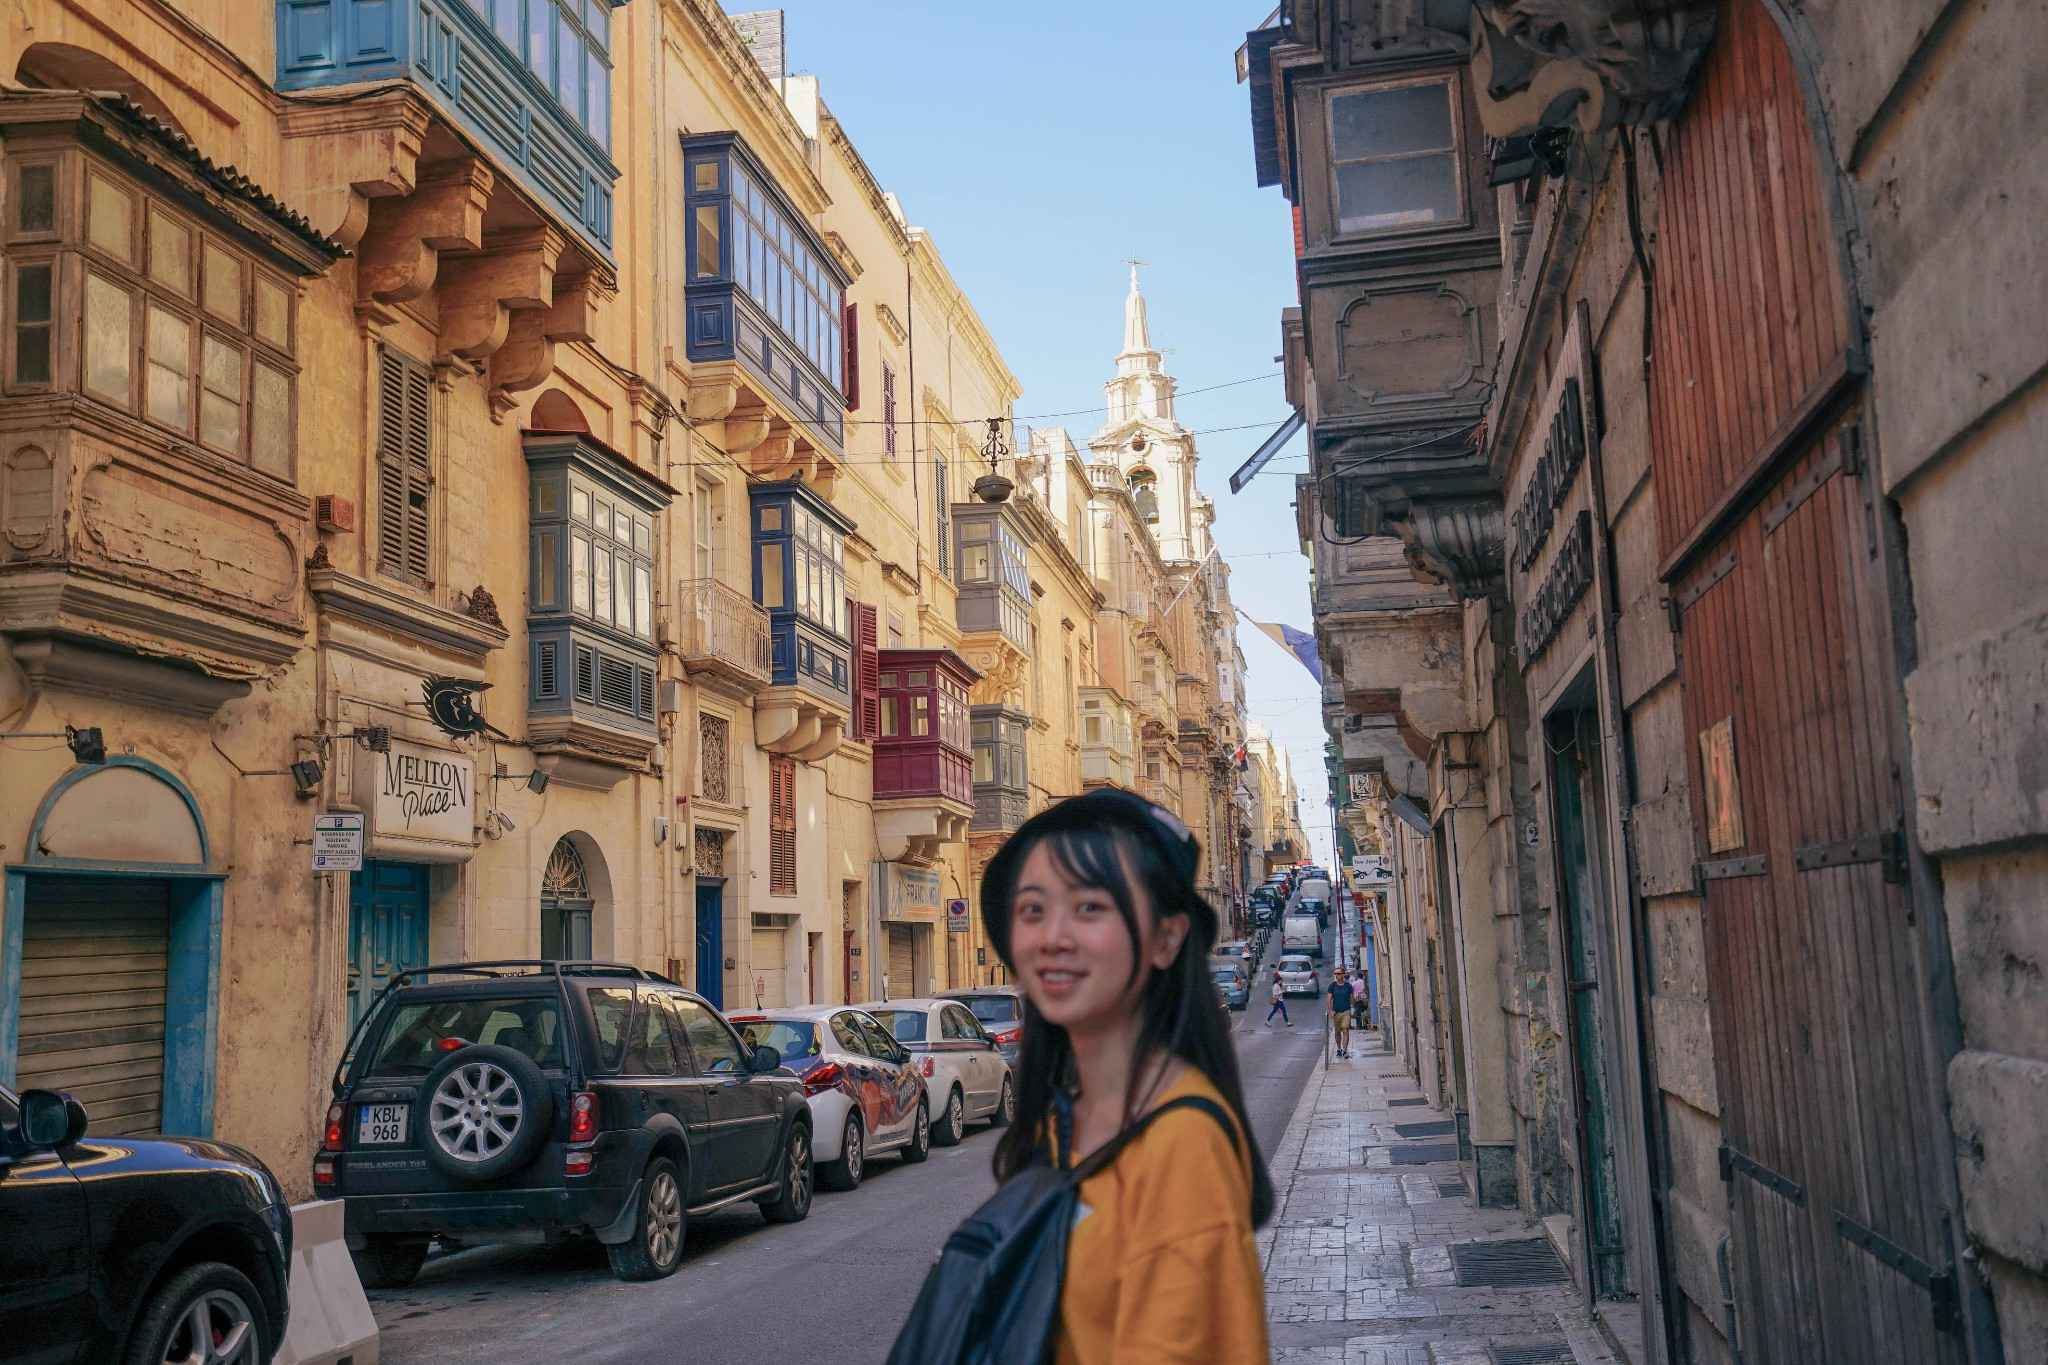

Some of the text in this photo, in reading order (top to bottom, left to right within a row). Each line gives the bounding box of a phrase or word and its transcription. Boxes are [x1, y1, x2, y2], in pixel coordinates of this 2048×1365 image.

[383, 752, 467, 807] MELITON
[402, 779, 451, 831] Place
[373, 1107, 401, 1123] KBL
[372, 1125, 399, 1141] 968
